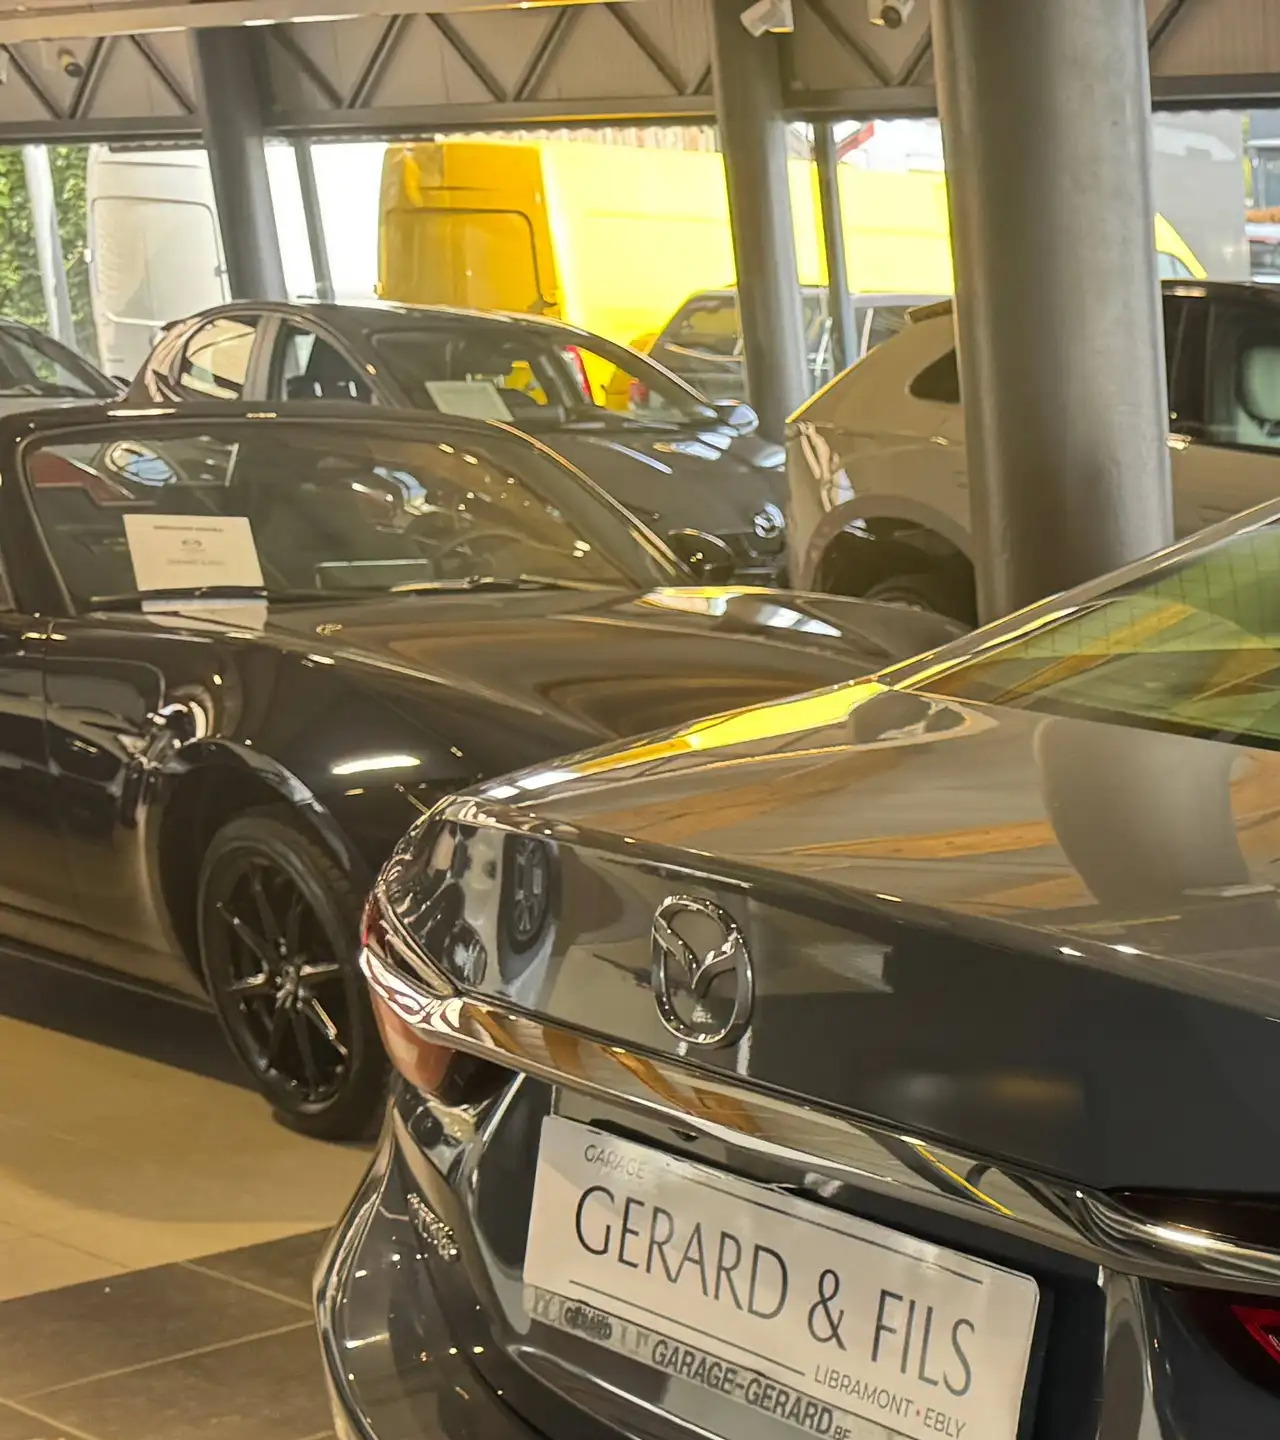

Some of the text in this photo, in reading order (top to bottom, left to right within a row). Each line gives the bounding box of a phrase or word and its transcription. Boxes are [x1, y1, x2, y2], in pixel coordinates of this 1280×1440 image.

[584, 1144, 648, 1180] GARAGE
[575, 1184, 789, 1321] GERARD
[807, 1268, 848, 1352] &
[871, 1288, 976, 1398] FILS
[814, 1363, 967, 1440] LIBRAMONT EBLY
